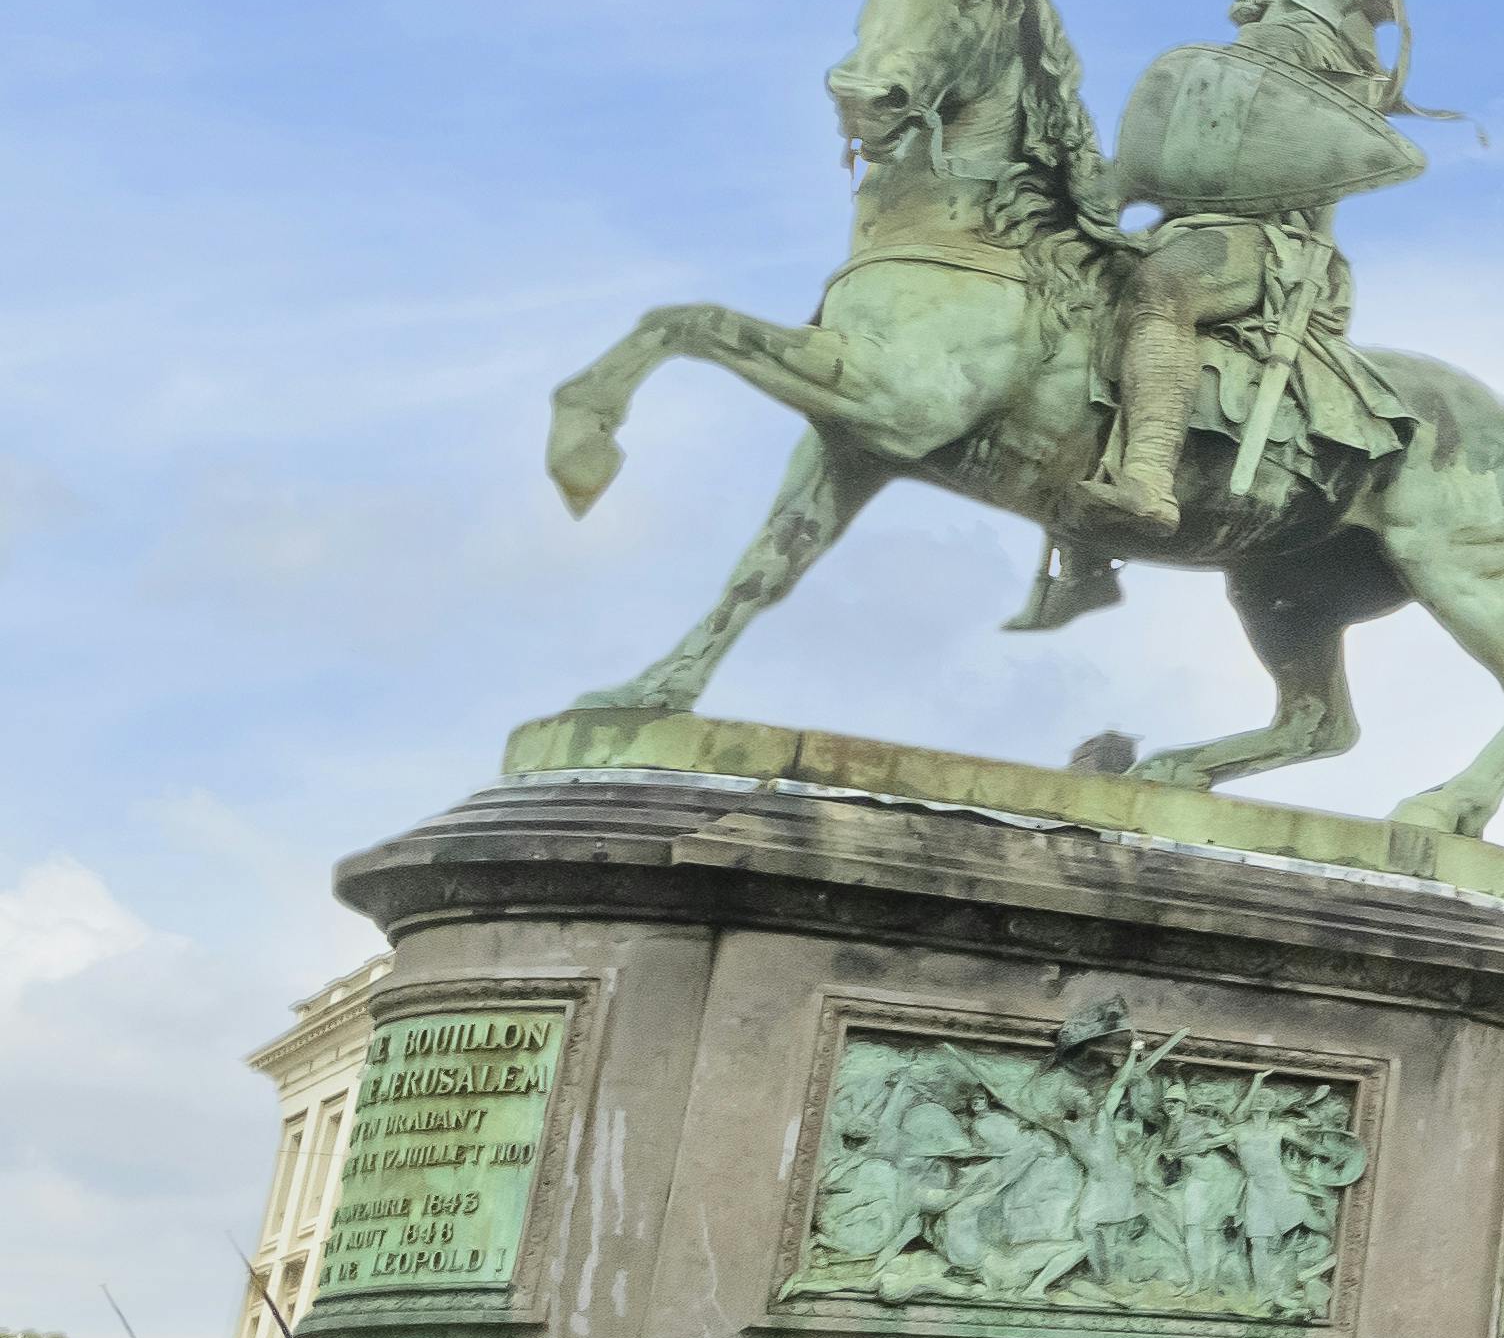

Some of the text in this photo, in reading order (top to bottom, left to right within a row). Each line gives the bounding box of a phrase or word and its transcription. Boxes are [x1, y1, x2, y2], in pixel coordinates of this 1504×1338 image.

[404, 1022, 551, 1057] BOUILLON
[421, 1189, 481, 1218] 1843
[371, 1248, 485, 1277] LEOPOLD
